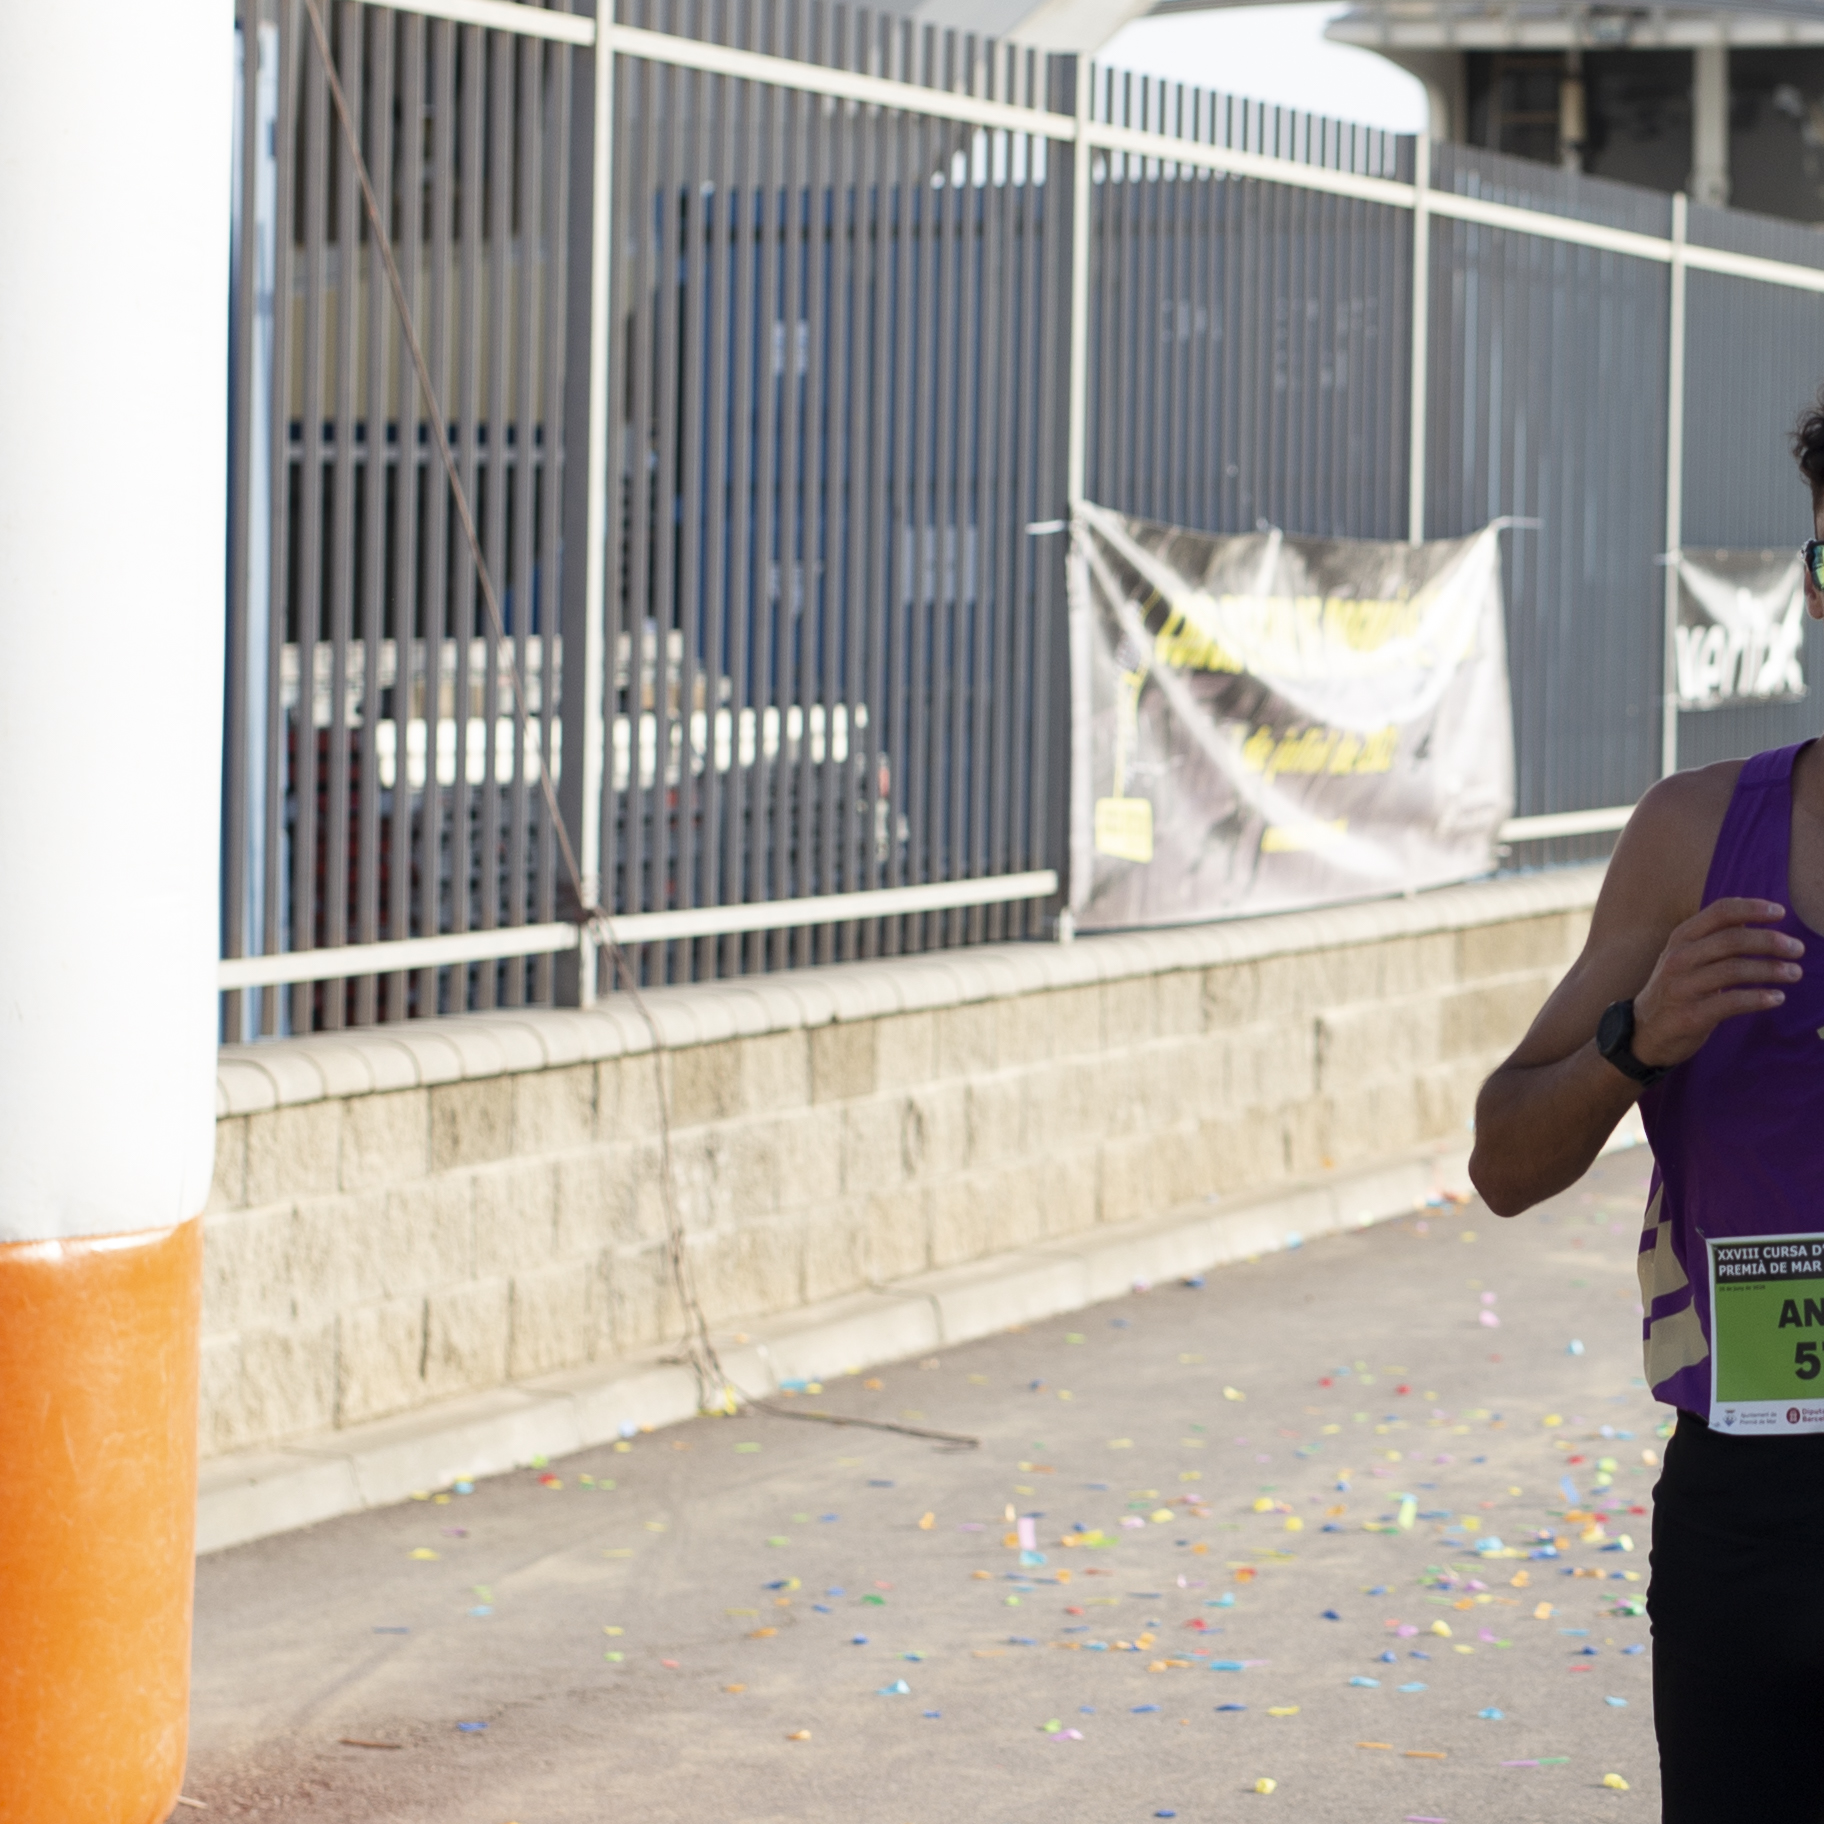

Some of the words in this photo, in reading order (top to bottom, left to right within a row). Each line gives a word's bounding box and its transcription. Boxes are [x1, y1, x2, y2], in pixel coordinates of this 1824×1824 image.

[1718, 1247, 1760, 1261] XXVIII
[1763, 1244, 1808, 1259] CURSA
[1718, 1259, 1767, 1276] PREMIÀ
[1770, 1261, 1788, 1274] DE
[1791, 1260, 1823, 1272] MAR
